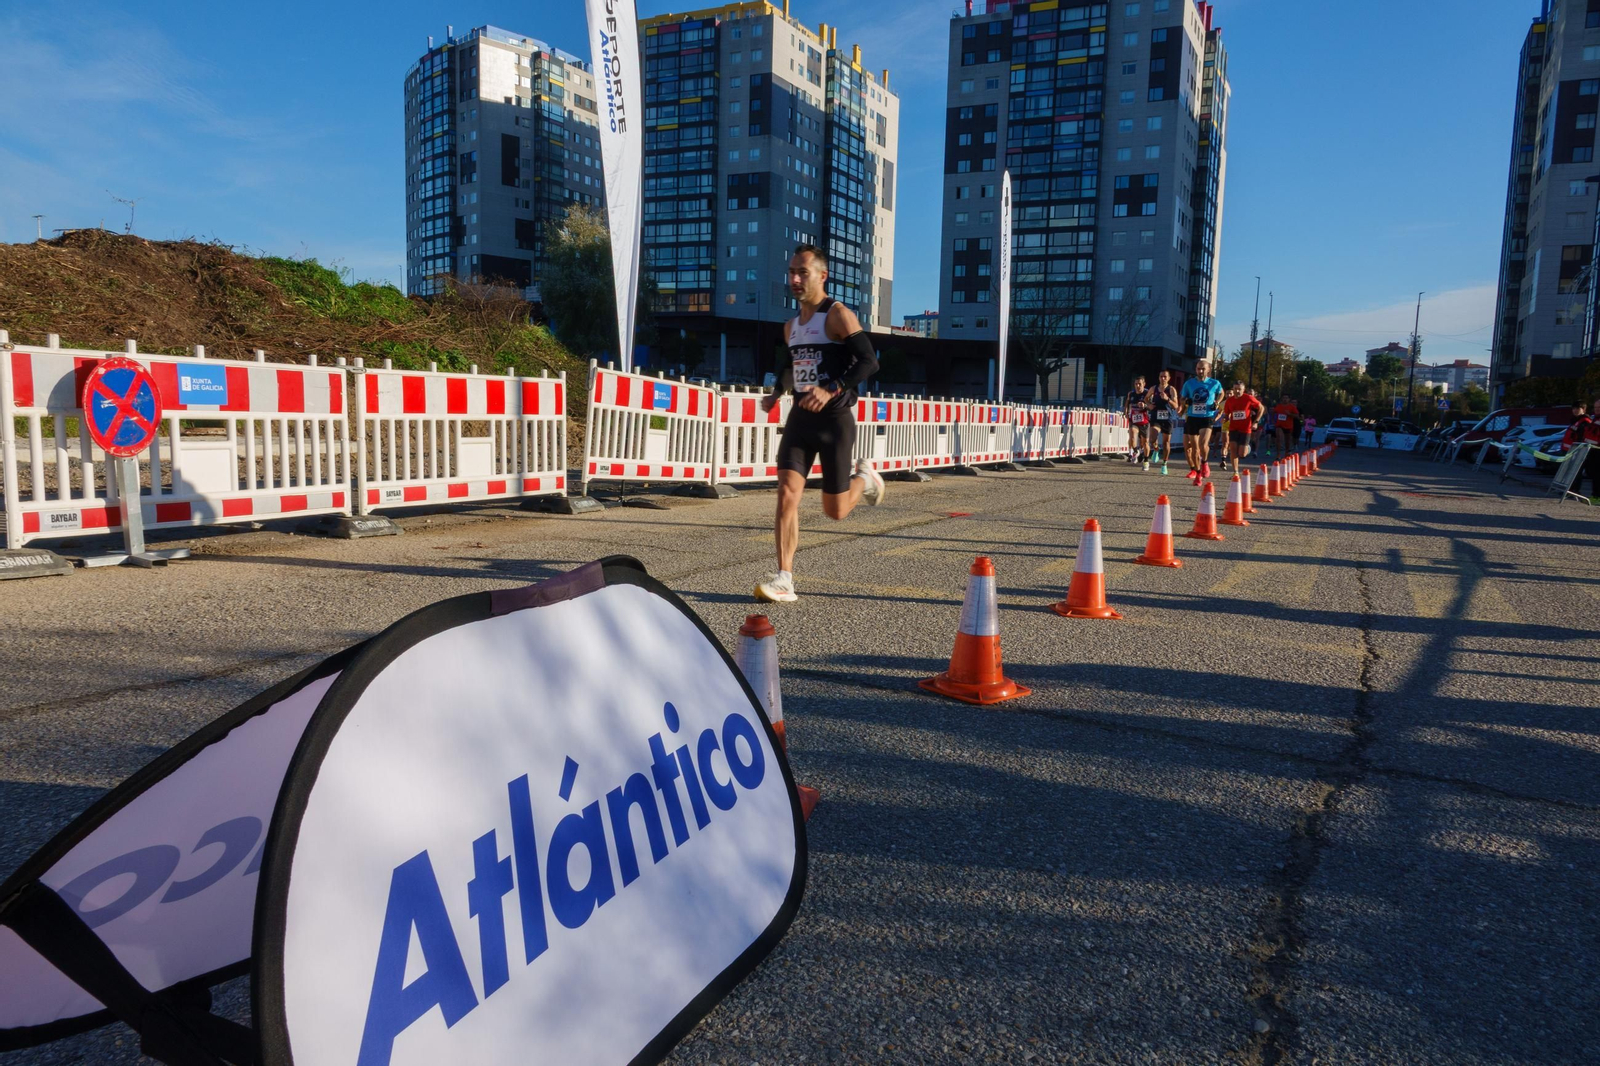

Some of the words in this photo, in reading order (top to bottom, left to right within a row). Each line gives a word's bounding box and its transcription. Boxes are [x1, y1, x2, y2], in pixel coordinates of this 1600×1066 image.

[599, 29, 618, 133] Atlántico
[795, 369, 817, 382] 226
[201, 384, 224, 392] GALICIA
[50, 513, 78, 523] BAYGAR
[358, 701, 766, 1066] Atlántico
